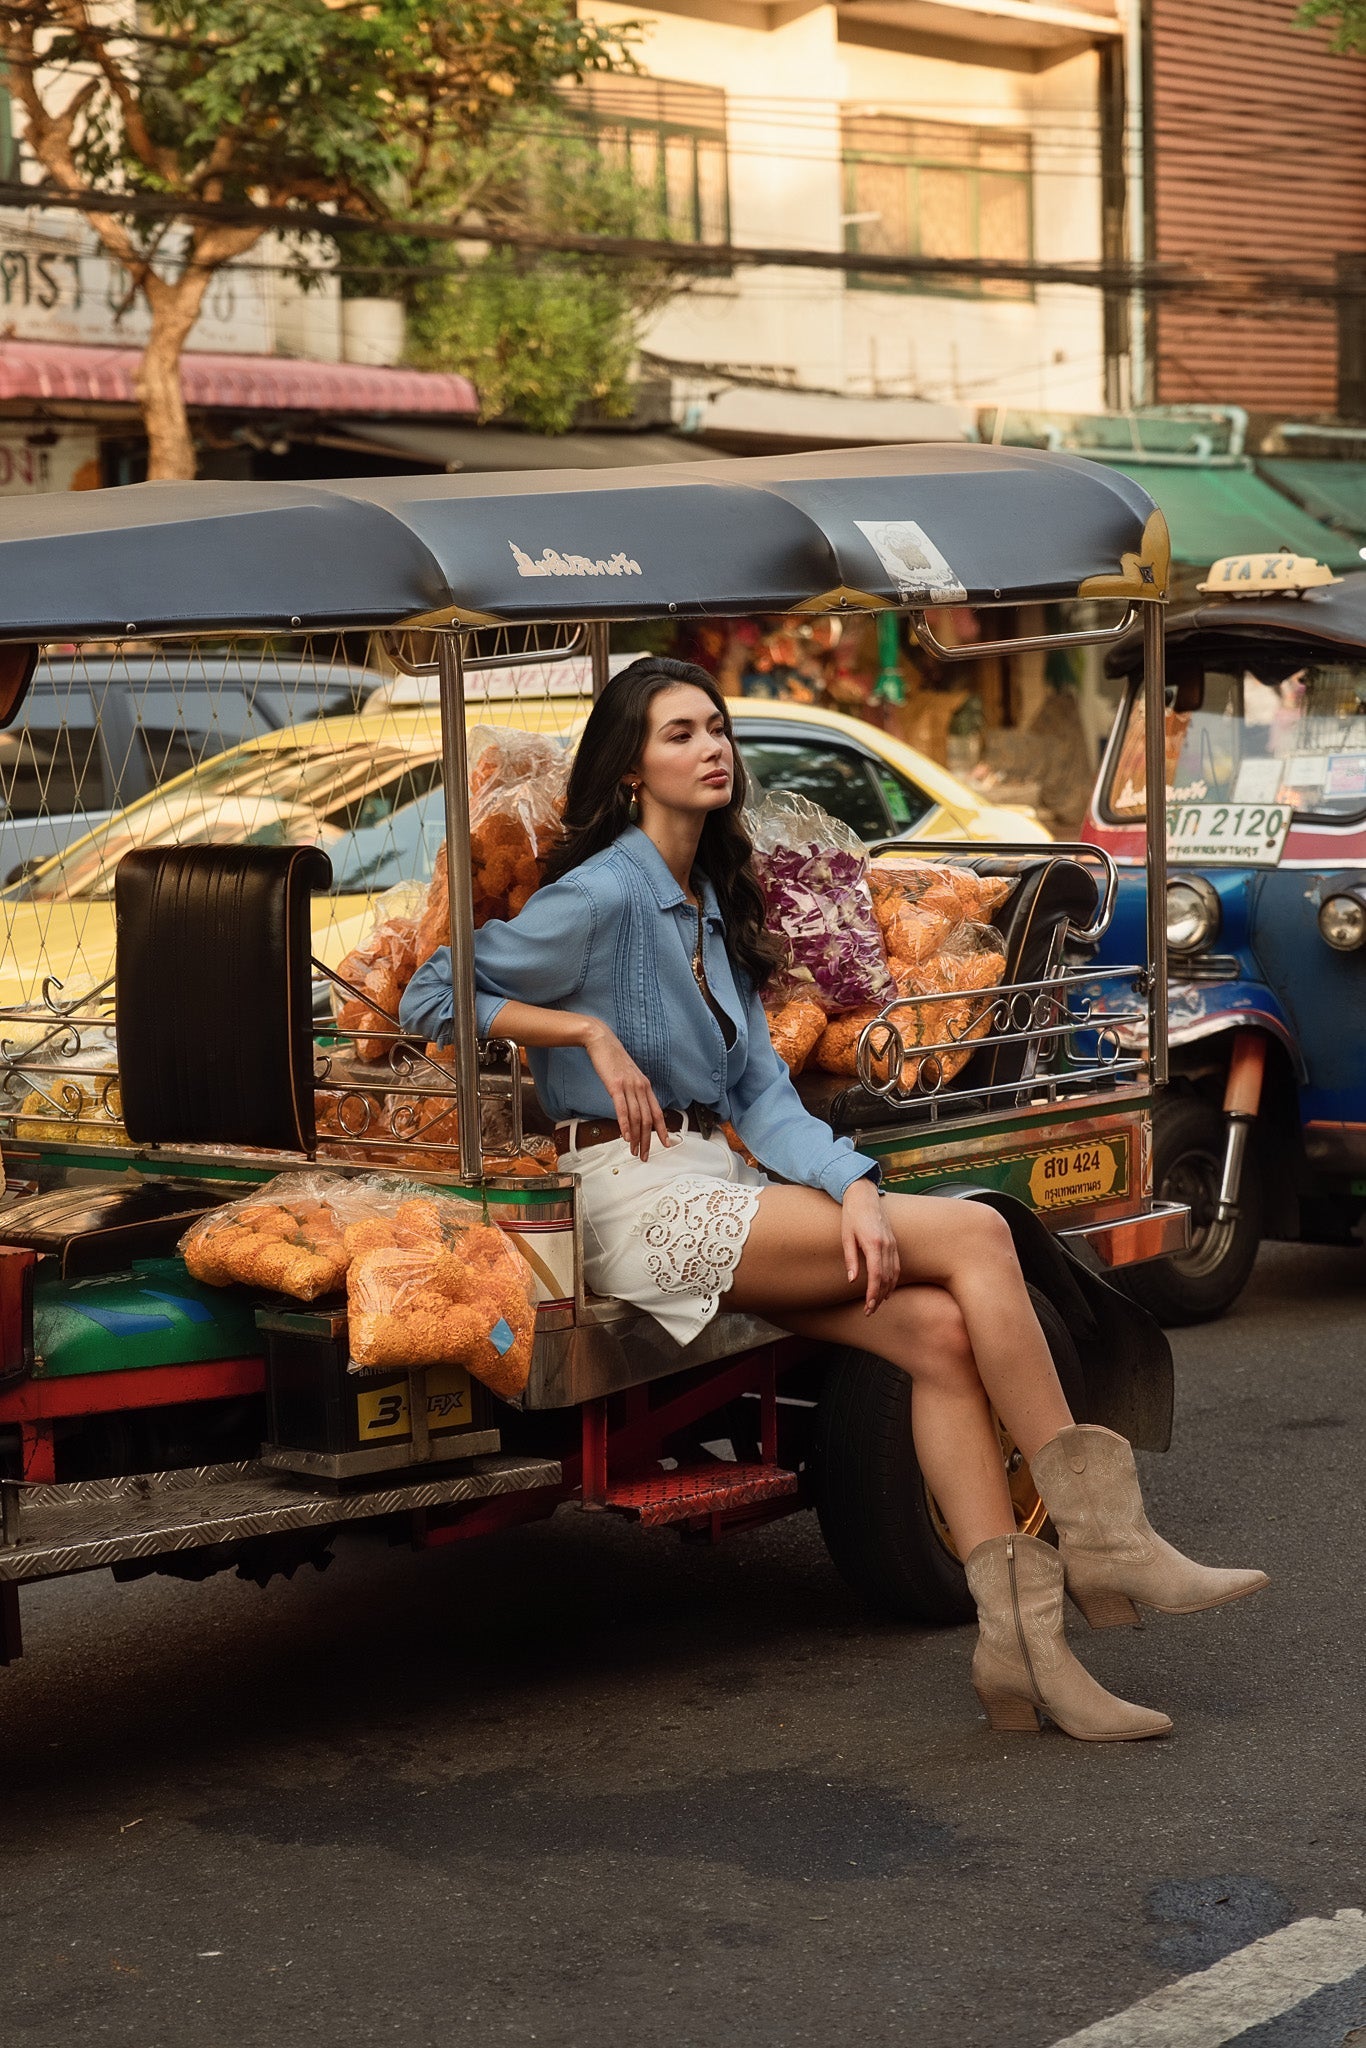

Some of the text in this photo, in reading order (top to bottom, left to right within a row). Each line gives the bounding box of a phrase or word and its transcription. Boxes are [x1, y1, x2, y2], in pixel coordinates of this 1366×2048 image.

[1210, 808, 1283, 837] 2120
[1044, 1150, 1101, 1179] สข 424
[1044, 1180, 1102, 1203] กรุงเทพมหานคร
[367, 1391, 464, 1429] 3-AX
